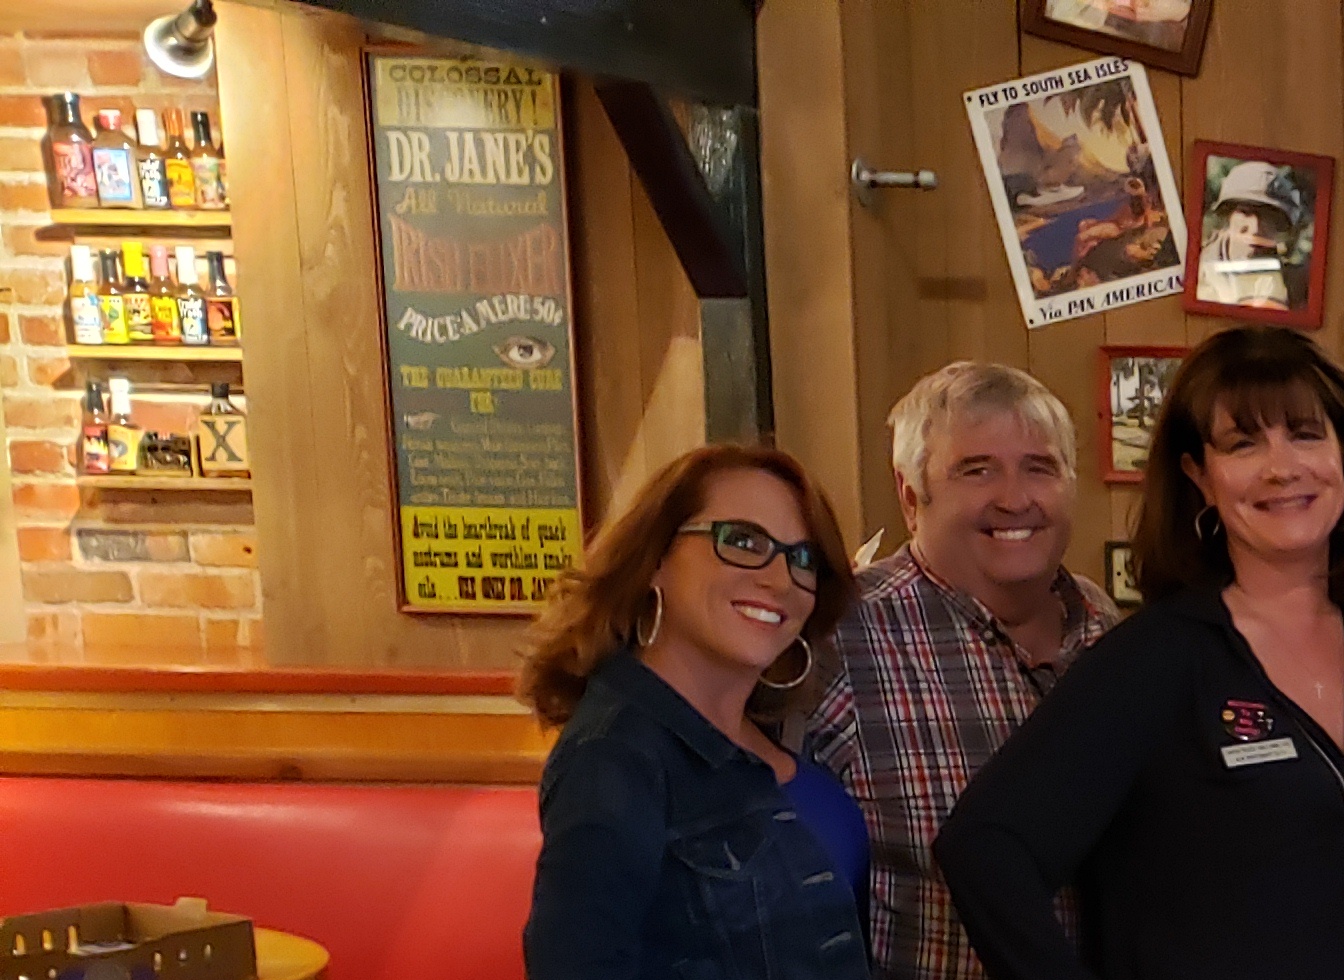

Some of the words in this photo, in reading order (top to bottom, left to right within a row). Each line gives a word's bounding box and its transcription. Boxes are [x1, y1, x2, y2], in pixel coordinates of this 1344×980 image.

[389, 64, 542, 86] COLOSSAL
[979, 91, 999, 109] FLY
[1002, 86, 1018, 102] TO
[1023, 74, 1065, 97] SOUTH
[1069, 67, 1092, 87] SEA
[1095, 58, 1130, 79] ISLES
[386, 130, 441, 183] DR.
[444, 129, 554, 186] JANE'S
[475, 294, 531, 330] MERE
[1039, 304, 1062, 322] Via
[1068, 294, 1096, 316] PAN
[1101, 275, 1185, 310] AMERICAN
[400, 366, 429, 389] THE
[413, 513, 439, 539] Avoid
[443, 514, 458, 539] the
[462, 515, 516, 540] heartbreak
[521, 516, 530, 541] of
[538, 516, 567, 548] quack
[413, 543, 459, 568] nostrums
[465, 544, 483, 568] and
[490, 545, 538, 569] worthless
